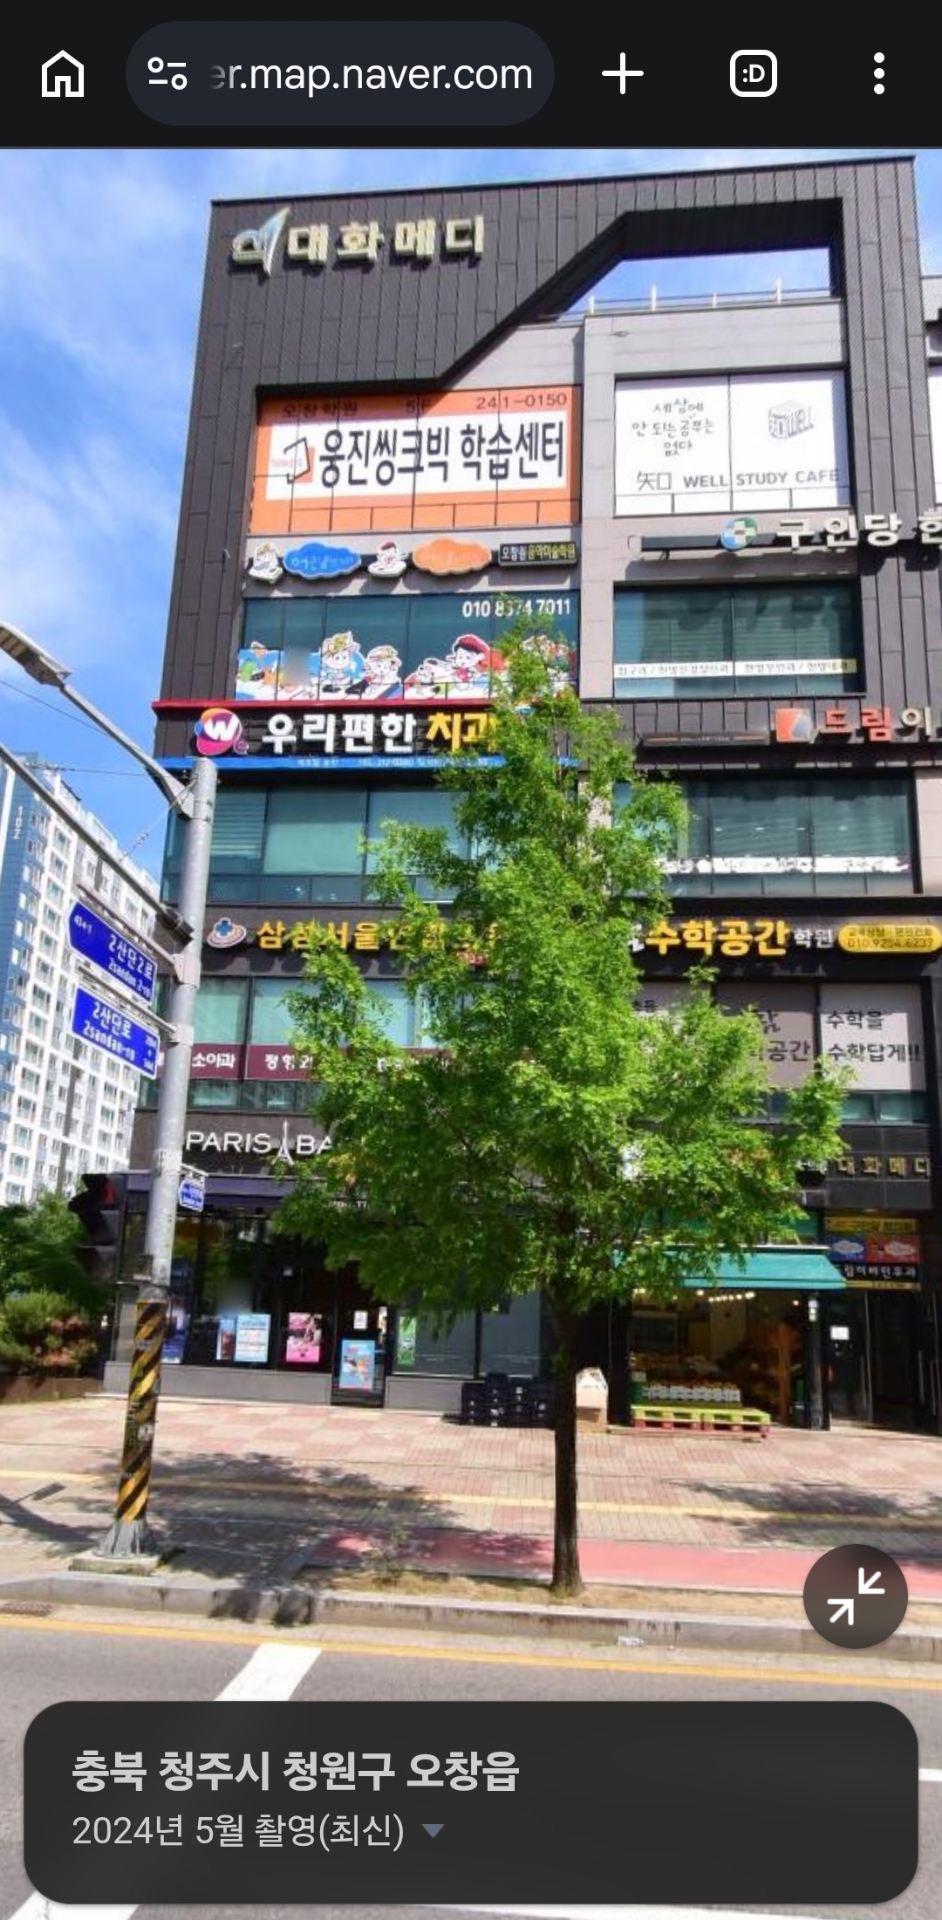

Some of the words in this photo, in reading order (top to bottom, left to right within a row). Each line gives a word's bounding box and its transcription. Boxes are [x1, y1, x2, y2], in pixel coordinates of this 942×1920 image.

[287, 214, 485, 264] 대화메디
[476, 393, 567, 411] 241-0150
[319, 428, 450, 489] 웅진씽크빅
[459, 420, 565, 482] 학습센터
[683, 474, 728, 489] WELL
[736, 471, 789, 486] STUDY
[795, 468, 840, 484] CAFE
[775, 512, 902, 552] 구인당
[462, 600, 492, 618] 010
[535, 598, 571, 616] 7011
[645, 919, 793, 957] 수학공간
[793, 927, 834, 949] 학원
[108, 933, 153, 981] 2산단2로
[92, 1000, 132, 1040] 2산단로
[826, 1009, 884, 1031] 수학을
[83, 1020, 136, 1062] 2sandan-ro
[750, 1040, 812, 1063] 공간
[192, 1052, 236, 1069] 소아과
[827, 1043, 920, 1064] 수학답게!!
[185, 1131, 272, 1153] PARIS
[836, 1156, 931, 1177] 대화메디
